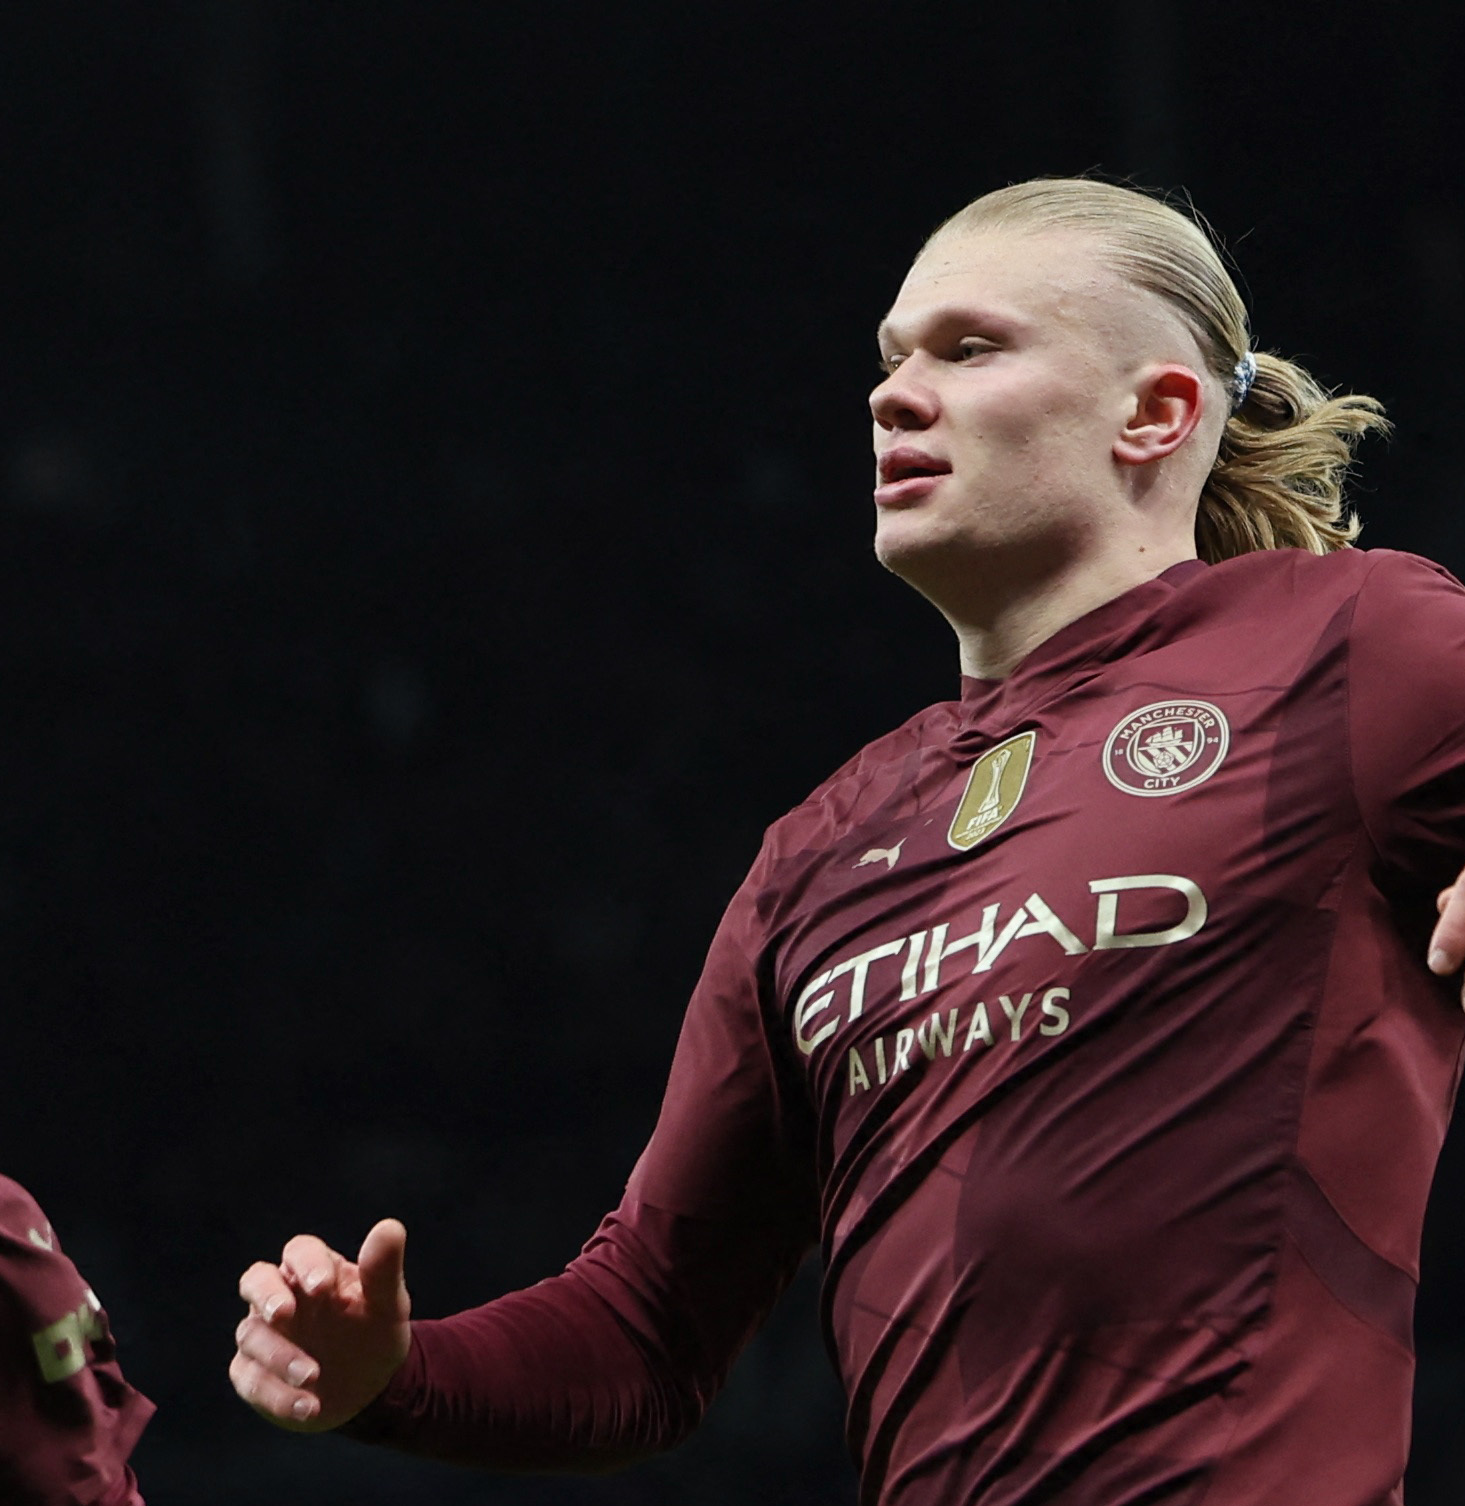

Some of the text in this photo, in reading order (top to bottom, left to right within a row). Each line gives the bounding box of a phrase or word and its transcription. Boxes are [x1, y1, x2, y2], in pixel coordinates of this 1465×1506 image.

[1119, 706, 1216, 740] MANCHESTER
[1143, 775, 1181, 790] CITY
[966, 807, 999, 831] FIFA
[793, 873, 1209, 1056] ETIHAD
[848, 986, 1072, 1097] AIRWAYS
